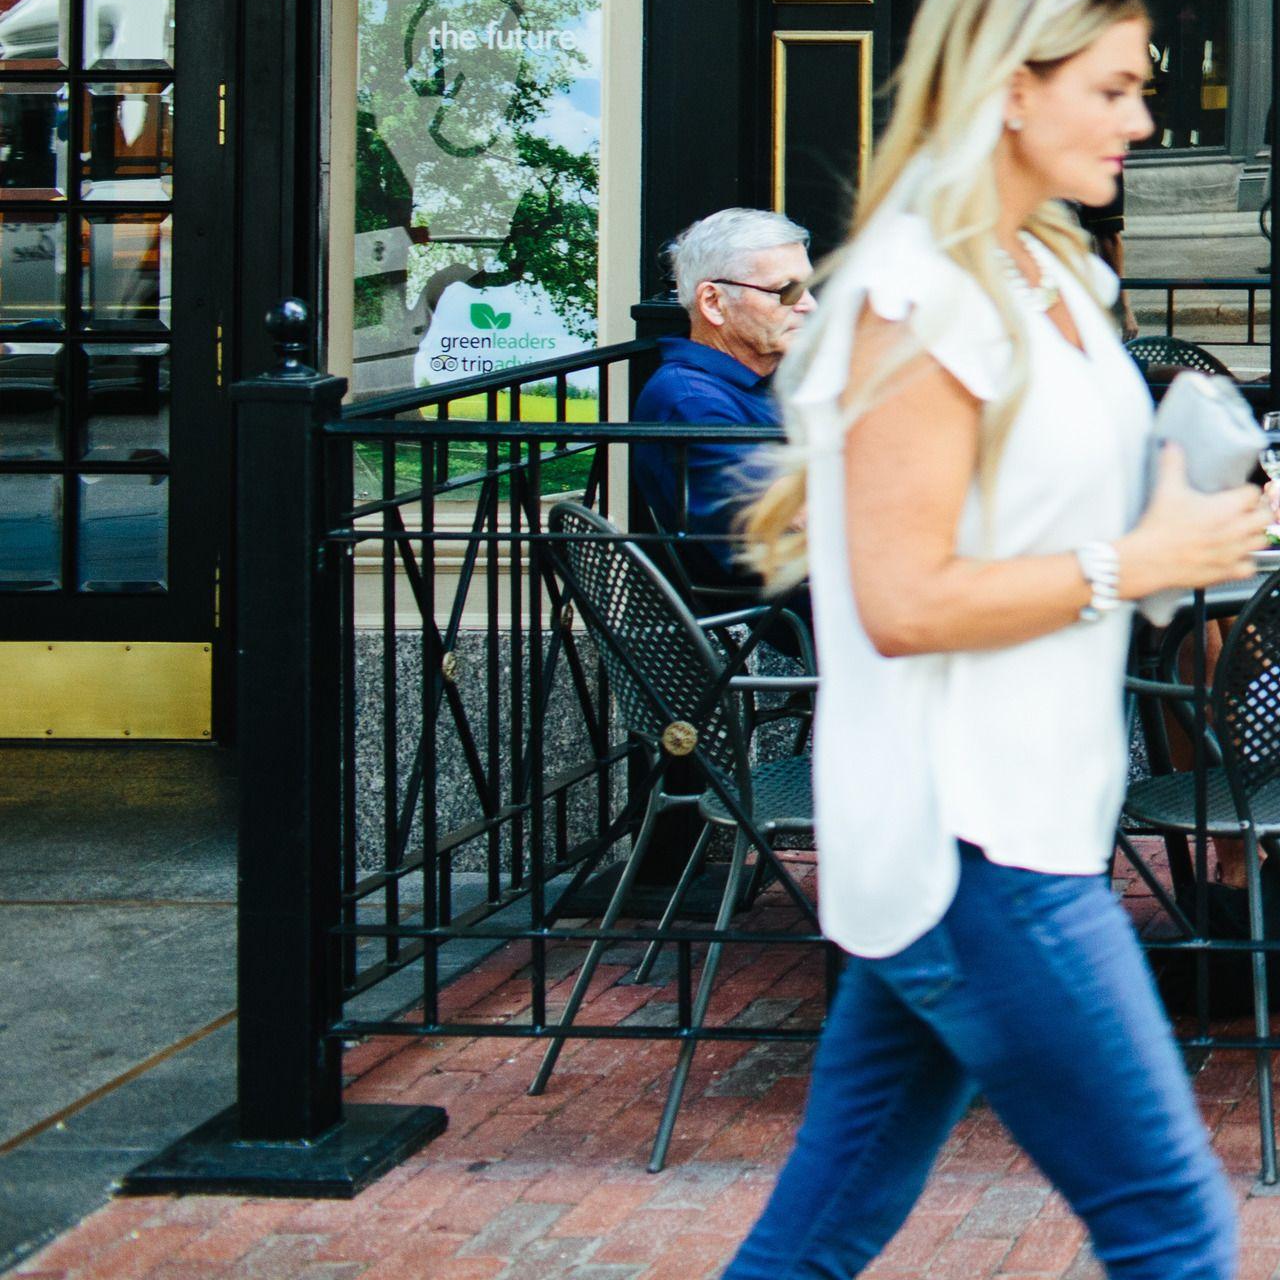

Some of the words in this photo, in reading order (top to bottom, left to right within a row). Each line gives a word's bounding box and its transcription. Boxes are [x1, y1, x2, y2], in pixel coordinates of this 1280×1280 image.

[428, 20, 477, 50] the
[486, 20, 577, 50] future
[440, 332, 557, 353] greenleaders
